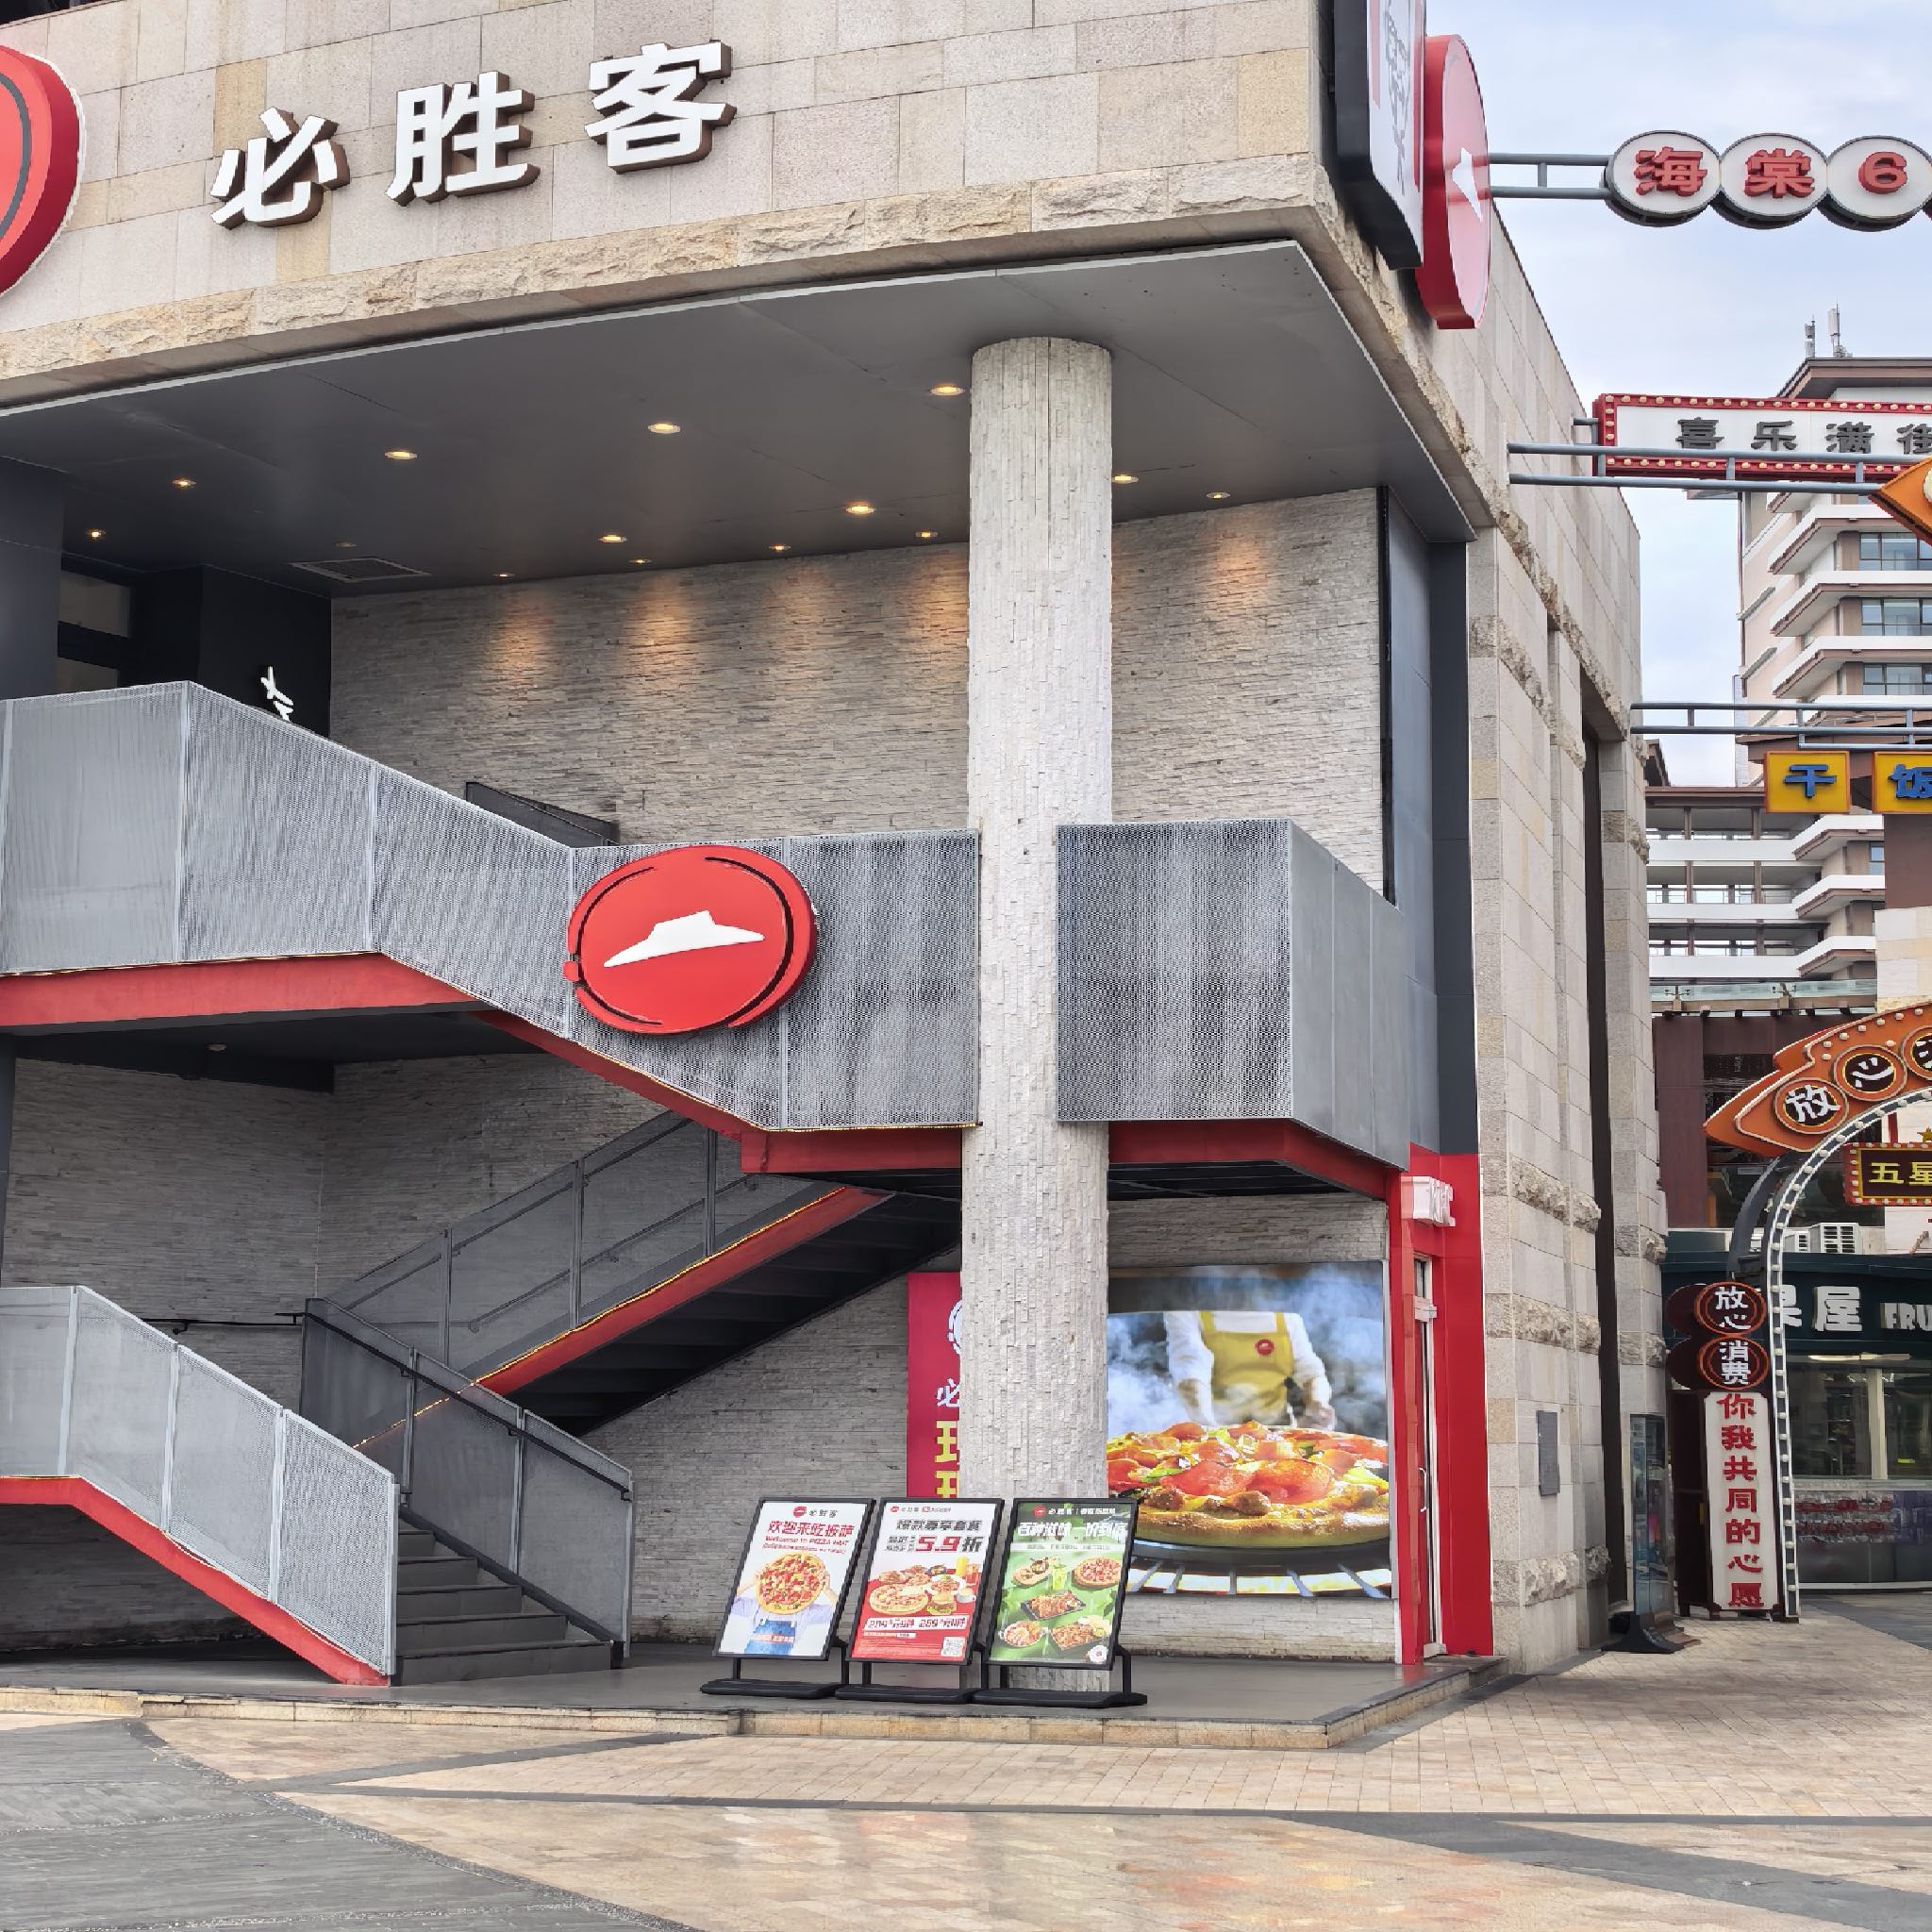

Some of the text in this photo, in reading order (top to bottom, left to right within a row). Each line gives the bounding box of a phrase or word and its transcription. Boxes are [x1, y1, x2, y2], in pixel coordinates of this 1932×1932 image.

[209, 40, 737, 230] 必胜客
[1716, 1392, 1764, 1607] 你我共同的心愿
